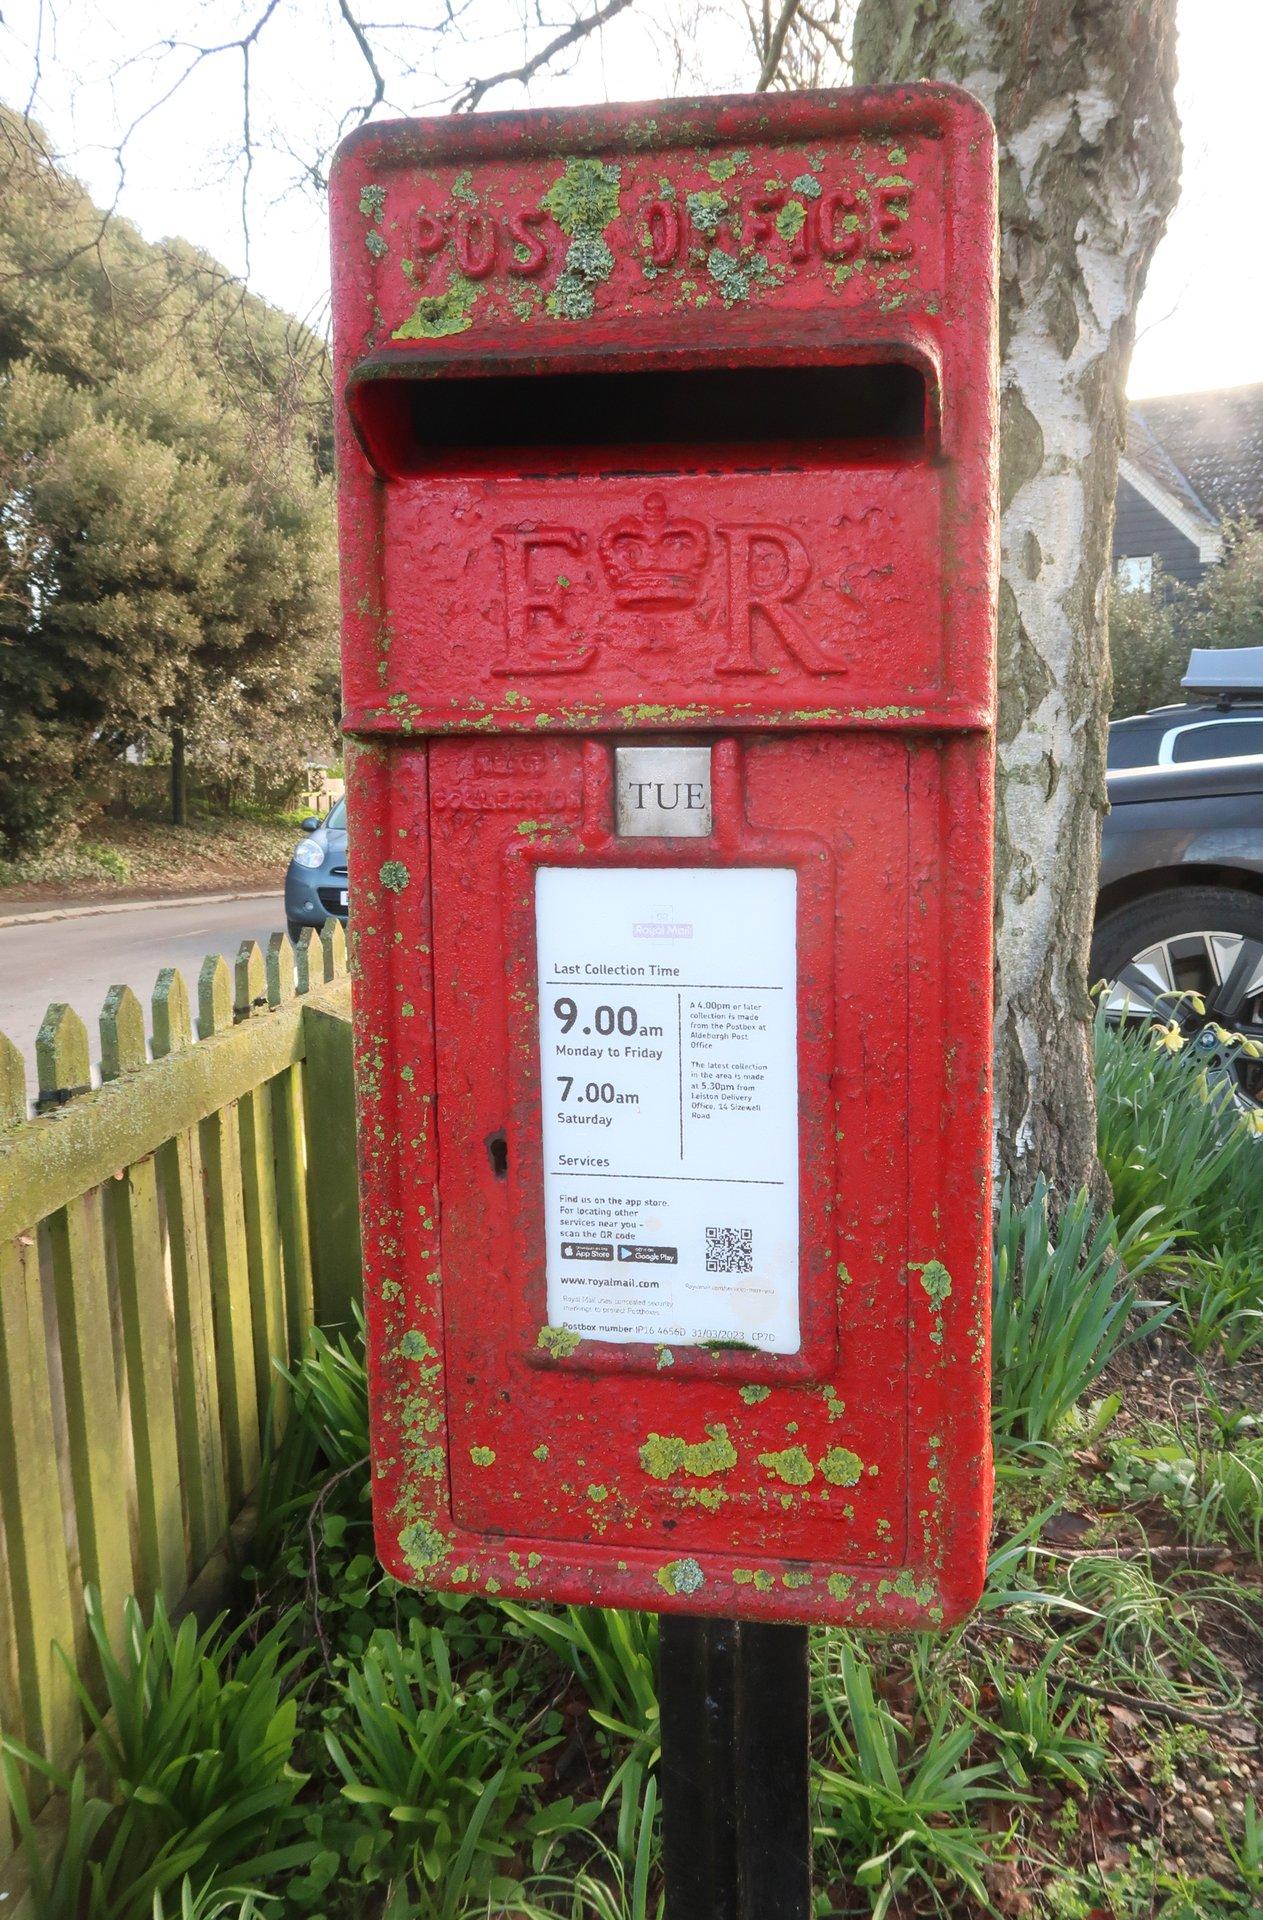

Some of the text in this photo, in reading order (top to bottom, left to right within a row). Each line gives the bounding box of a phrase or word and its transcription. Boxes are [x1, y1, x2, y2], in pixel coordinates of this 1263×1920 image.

[411, 206, 598, 281] POS
[628, 782, 706, 810] TUE
[554, 963, 680, 976] Last Collection Time
[698, 1001, 730, 1011] 4.00pm
[553, 997, 663, 1037] 9.00am
[690, 1032, 729, 1040] Aldeburgh
[556, 1045, 663, 1060] Monday to Friday
[557, 1076, 639, 1104] 7.00am
[702, 1082, 734, 1091] 5.30pm
[721, 1094, 752, 1102] Delivery
[558, 1113, 612, 1127] Saturday
[559, 1155, 610, 1167] Services
[560, 1195, 578, 1203] Find
[608, 1196, 623, 1205] the
[625, 1198, 641, 1207] app
[644, 1198, 670, 1207] store.
[560, 1206, 639, 1217] For locating other
[560, 1218, 595, 1227] services
[598, 1220, 618, 1228] near
[621, 1221, 637, 1230] you
[583, 1230, 597, 1238] the
[600, 1230, 613, 1240] QR
[615, 1231, 636, 1240] code
[576, 1250, 589, 1258] App
[635, 1253, 674, 1262] Google Play
[561, 1277, 660, 1289] www.royalmail.com
[563, 1322, 596, 1330] Postbox
[692, 1329, 744, 1340] 31/03/2023
